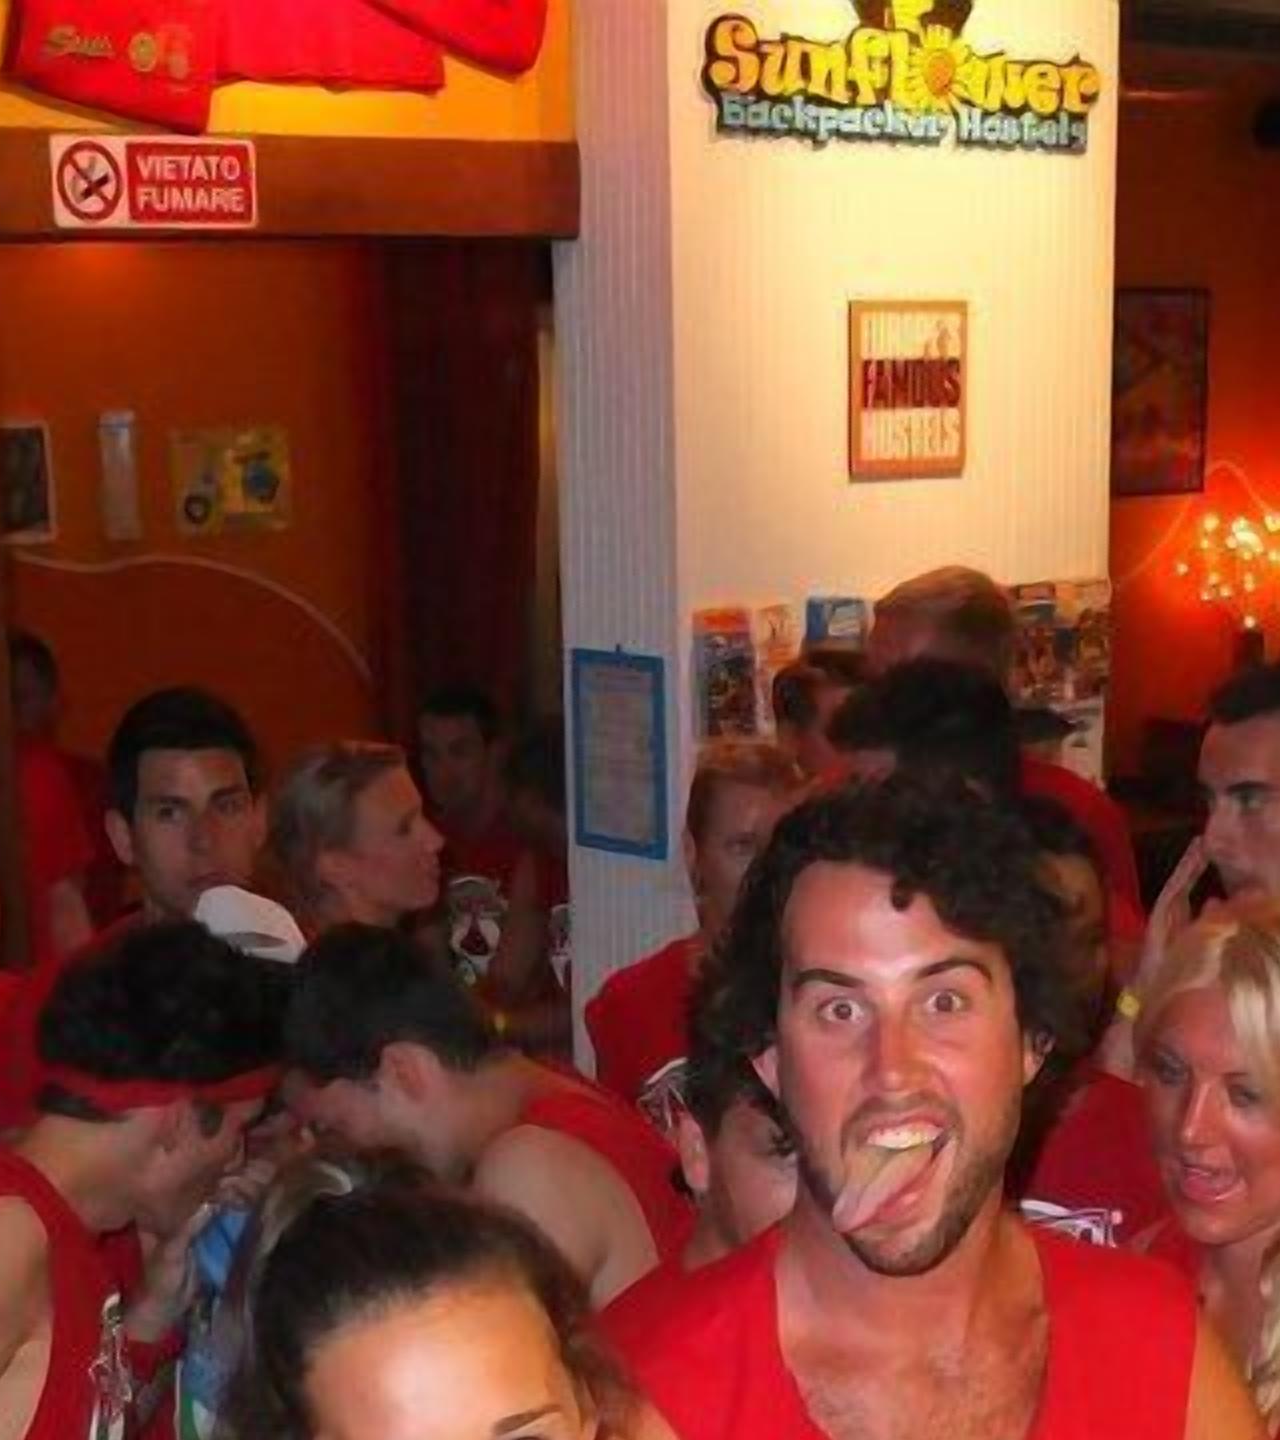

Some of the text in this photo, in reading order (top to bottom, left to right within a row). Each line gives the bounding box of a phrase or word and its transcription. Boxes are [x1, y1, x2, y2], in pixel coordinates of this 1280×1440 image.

[705, 17, 1101, 115] Sunflower
[135, 154, 242, 181] VIETATO
[138, 187, 245, 213] FUMARE
[862, 359, 961, 409] FAMOUS
